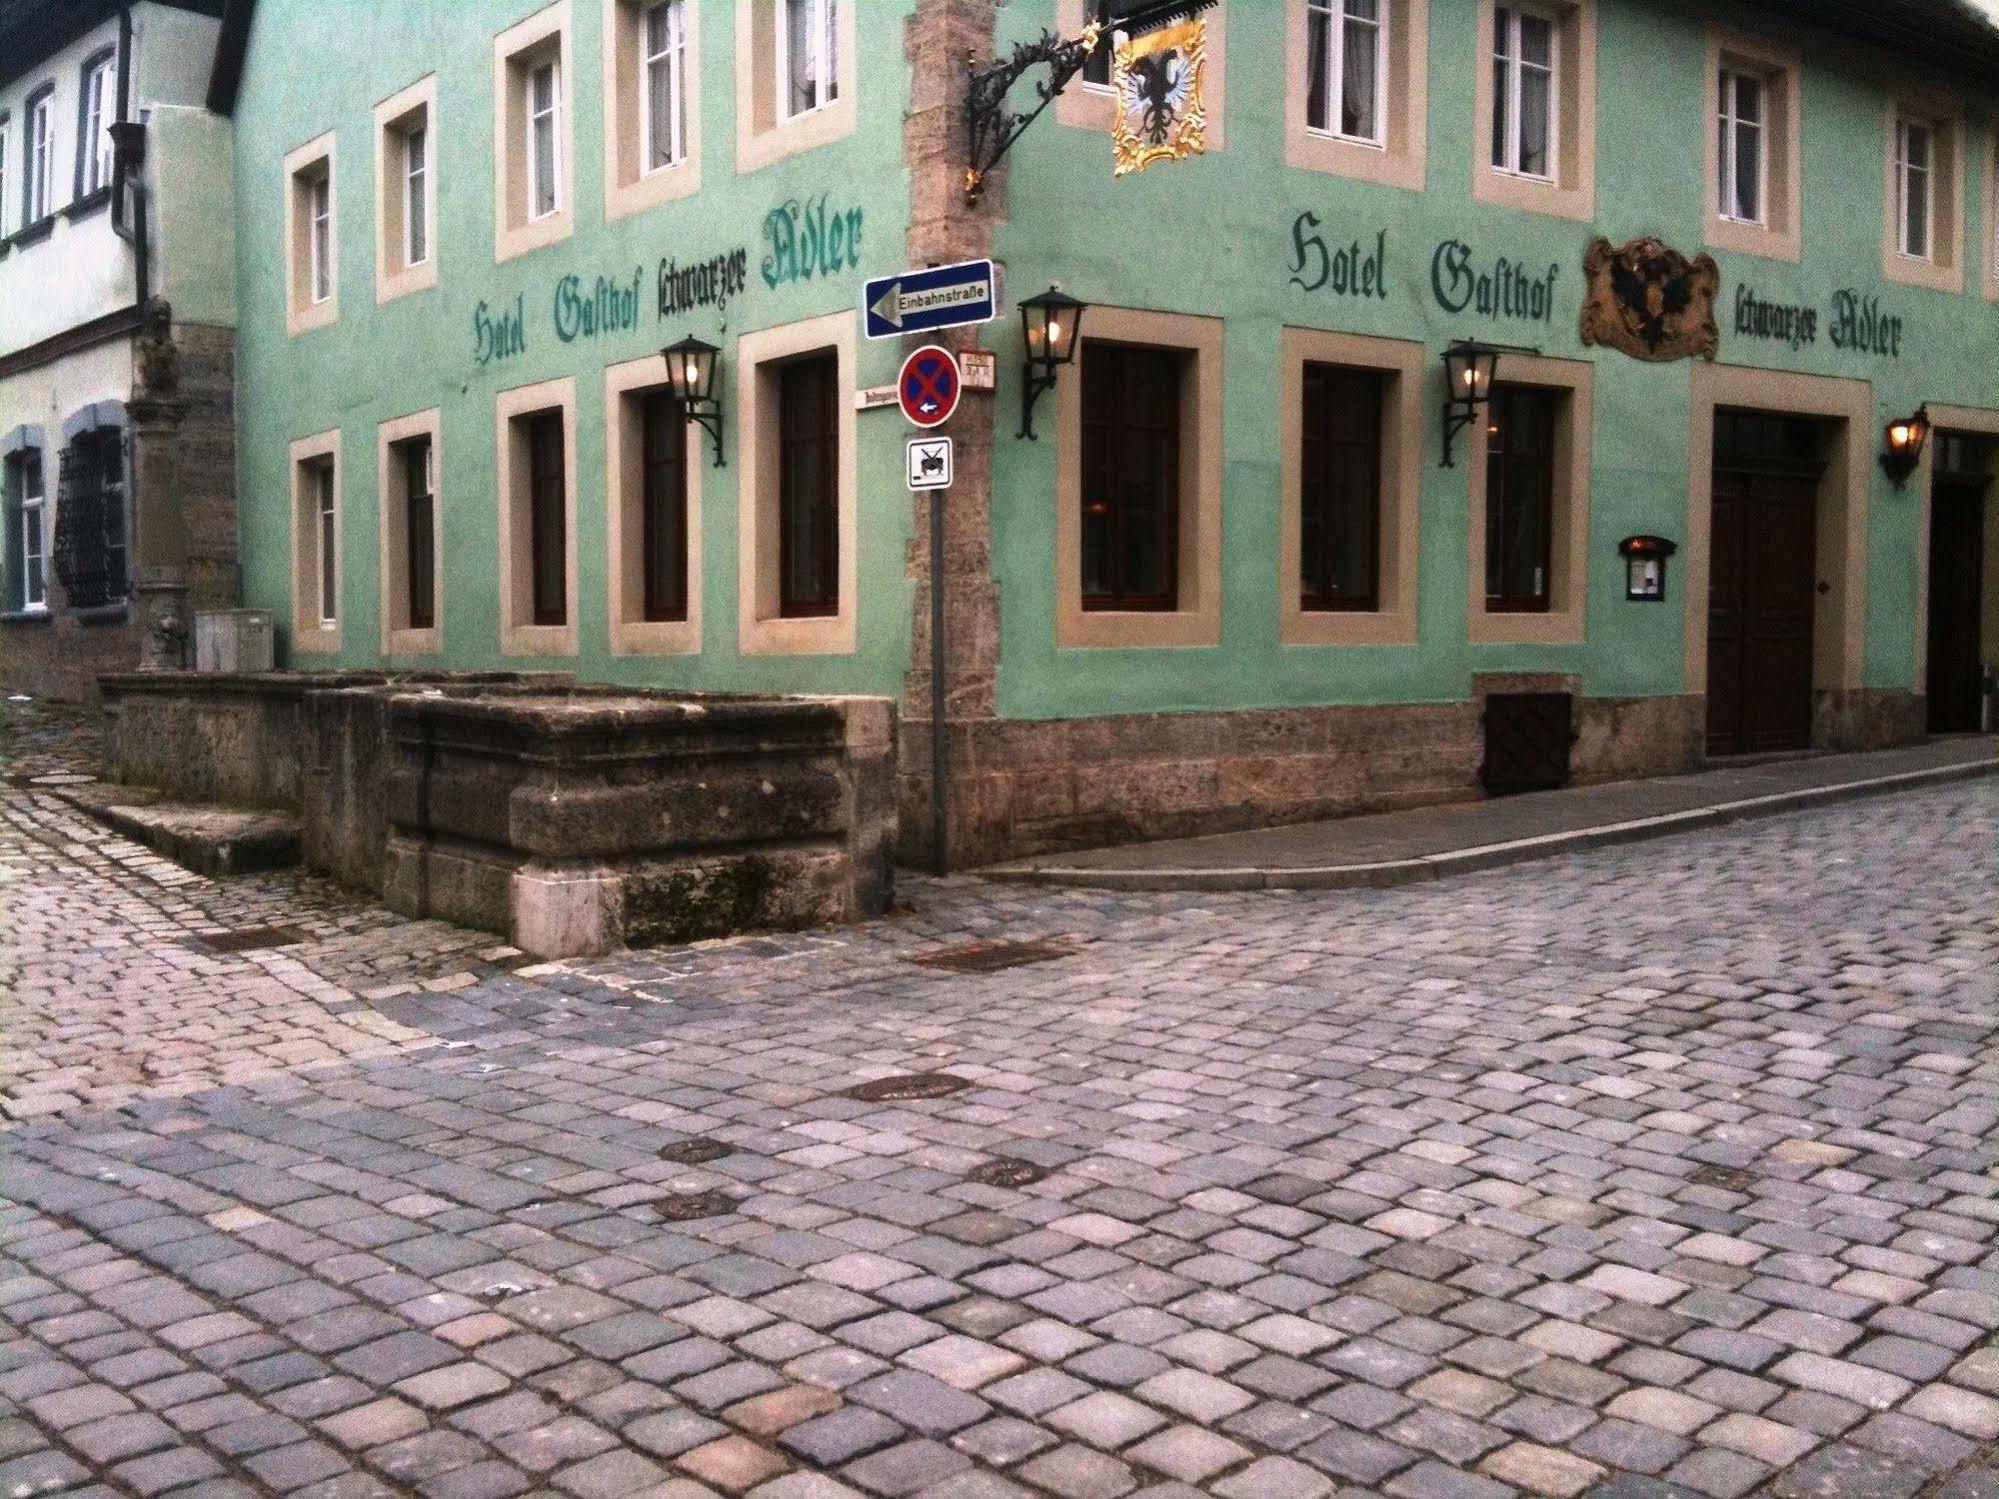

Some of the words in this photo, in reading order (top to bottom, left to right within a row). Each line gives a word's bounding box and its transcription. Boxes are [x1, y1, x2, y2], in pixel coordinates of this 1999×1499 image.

[474, 292, 526, 365] Hotel
[761, 194, 864, 290] Adler
[899, 285, 985, 310] Einbahnstraße
[1288, 211, 1388, 300] Hotel
[1829, 288, 1903, 358] Adler
